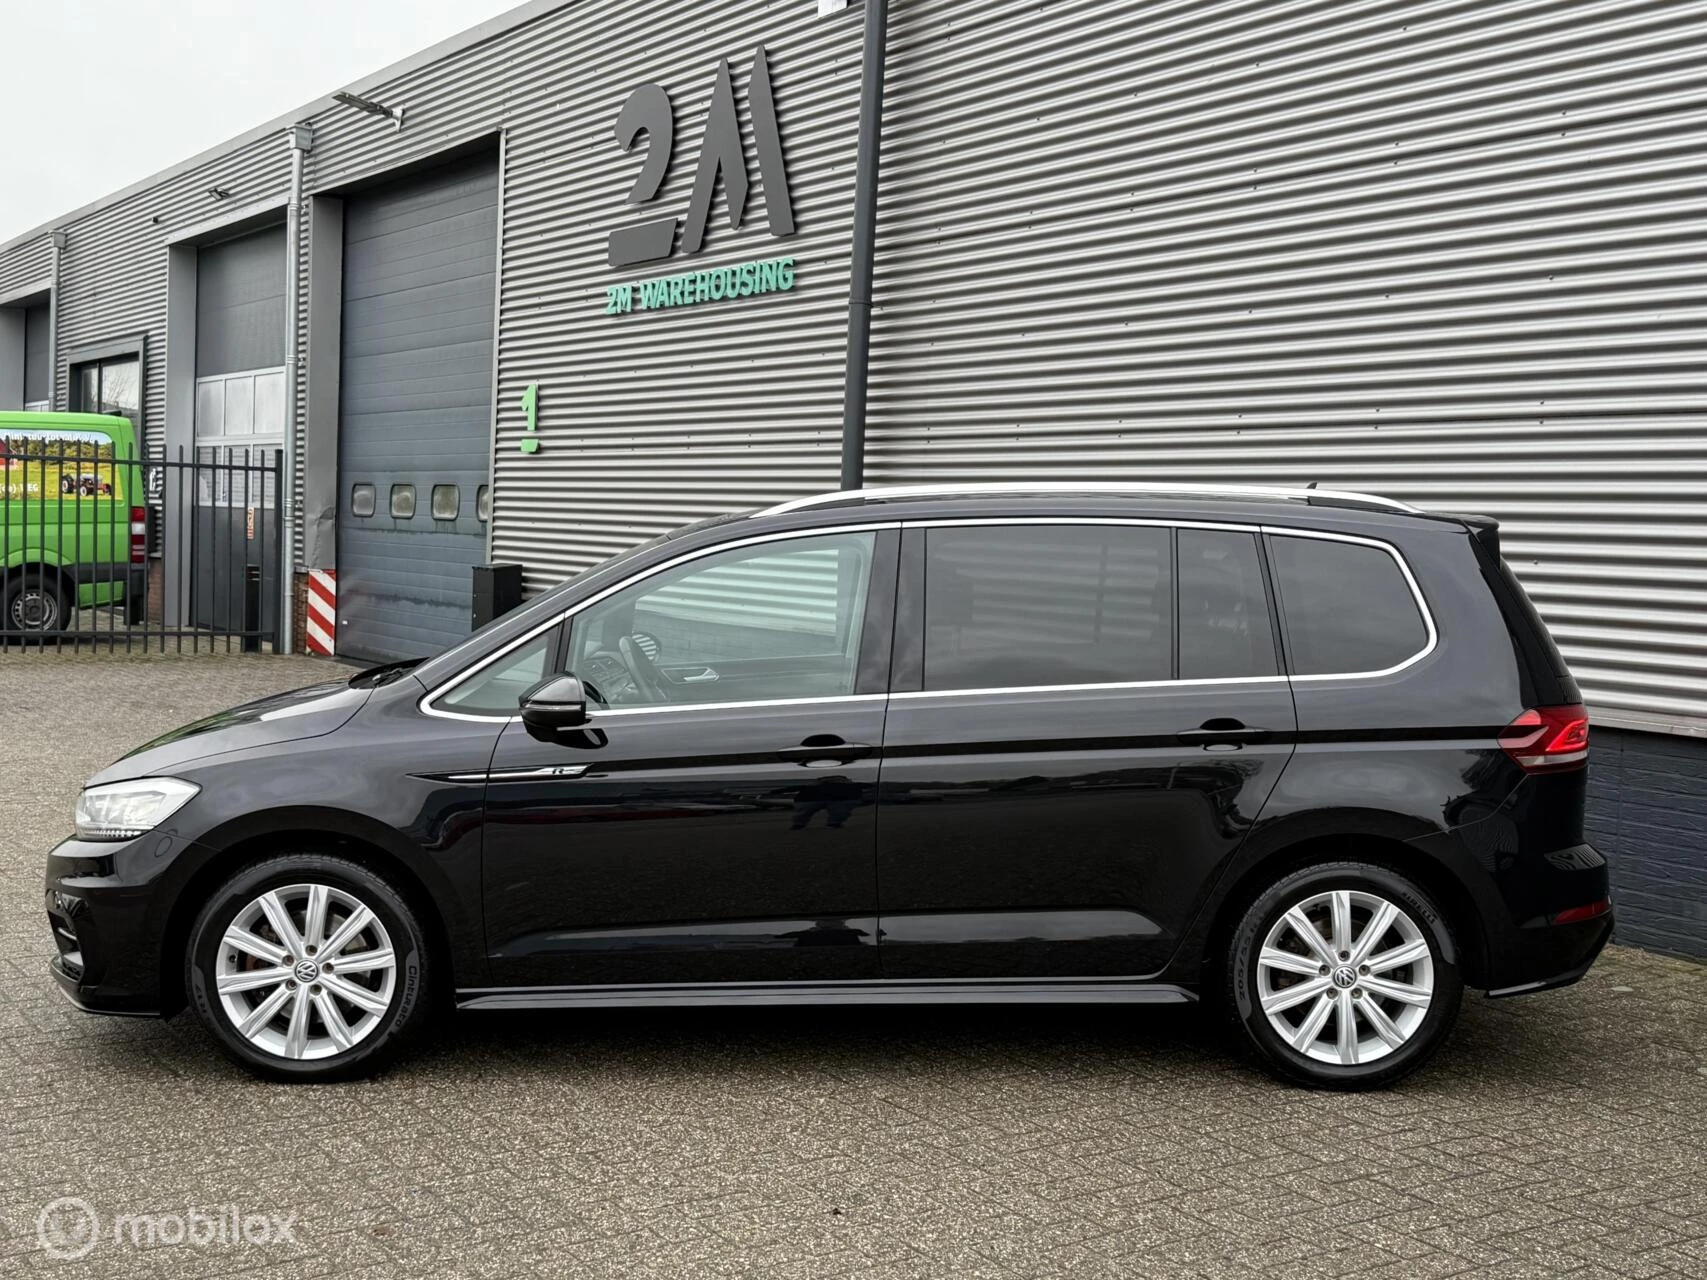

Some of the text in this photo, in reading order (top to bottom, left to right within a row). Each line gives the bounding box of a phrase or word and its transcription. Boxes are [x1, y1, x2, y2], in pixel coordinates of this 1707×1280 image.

[608, 44, 795, 266] 2M
[606, 257, 795, 314] 2M WAREHOUSING
